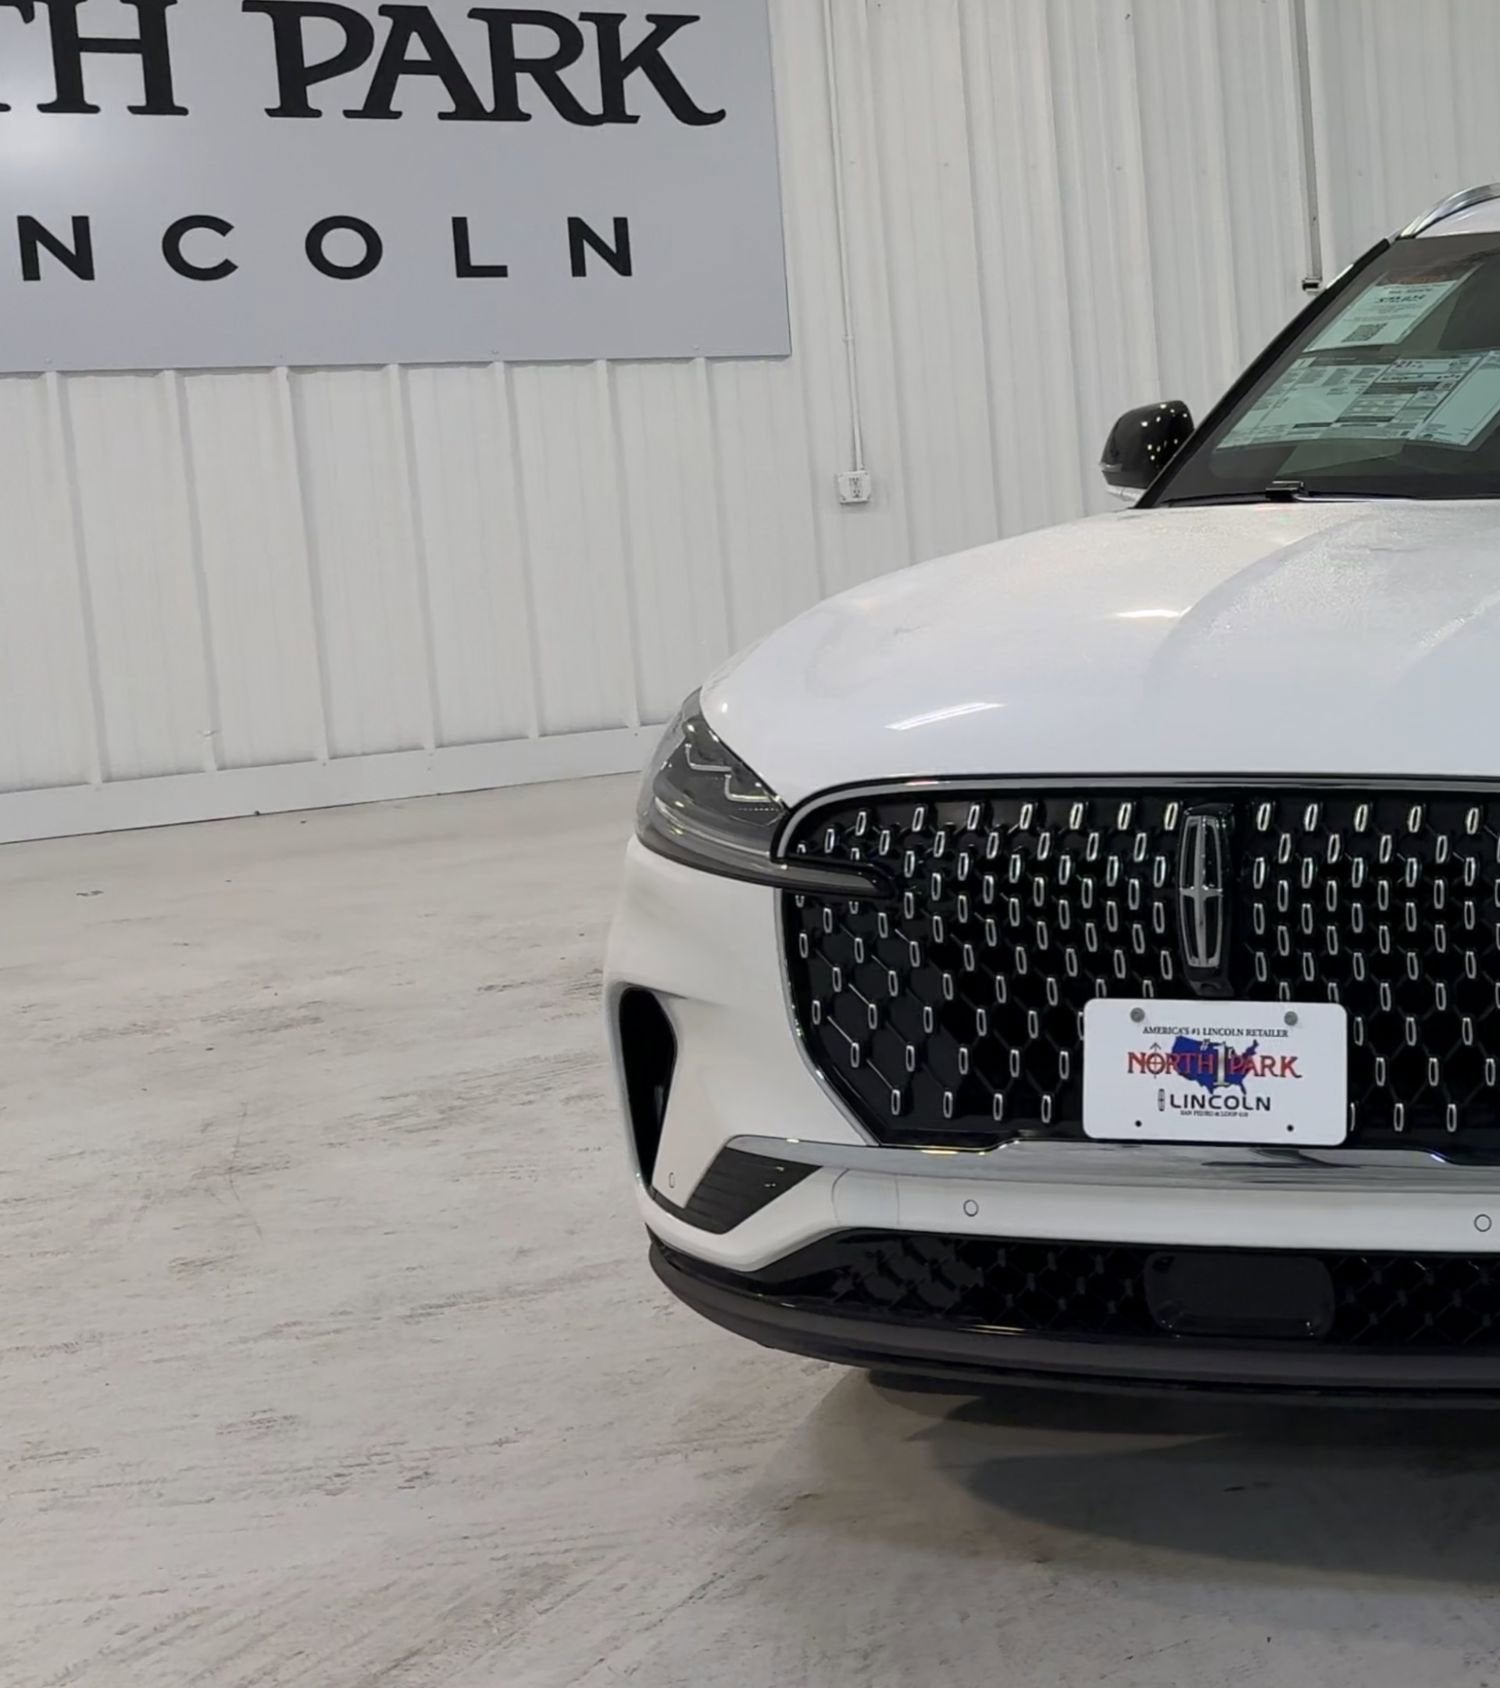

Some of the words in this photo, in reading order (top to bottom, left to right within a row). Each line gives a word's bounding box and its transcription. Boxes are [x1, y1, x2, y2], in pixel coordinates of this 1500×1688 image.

[242, 0, 727, 126] PARK
[16, 214, 634, 281] NCOLN
[1143, 1026, 1189, 1035] AMERICA'S
[1191, 1027, 1200, 1036] #1
[1202, 1028, 1244, 1036] LINCOLN
[1246, 1029, 1289, 1038] RETAILER
[1127, 1051, 1214, 1075] NORTH
[1230, 1054, 1303, 1079] PARK
[1170, 1094, 1271, 1111] LINCOLN
